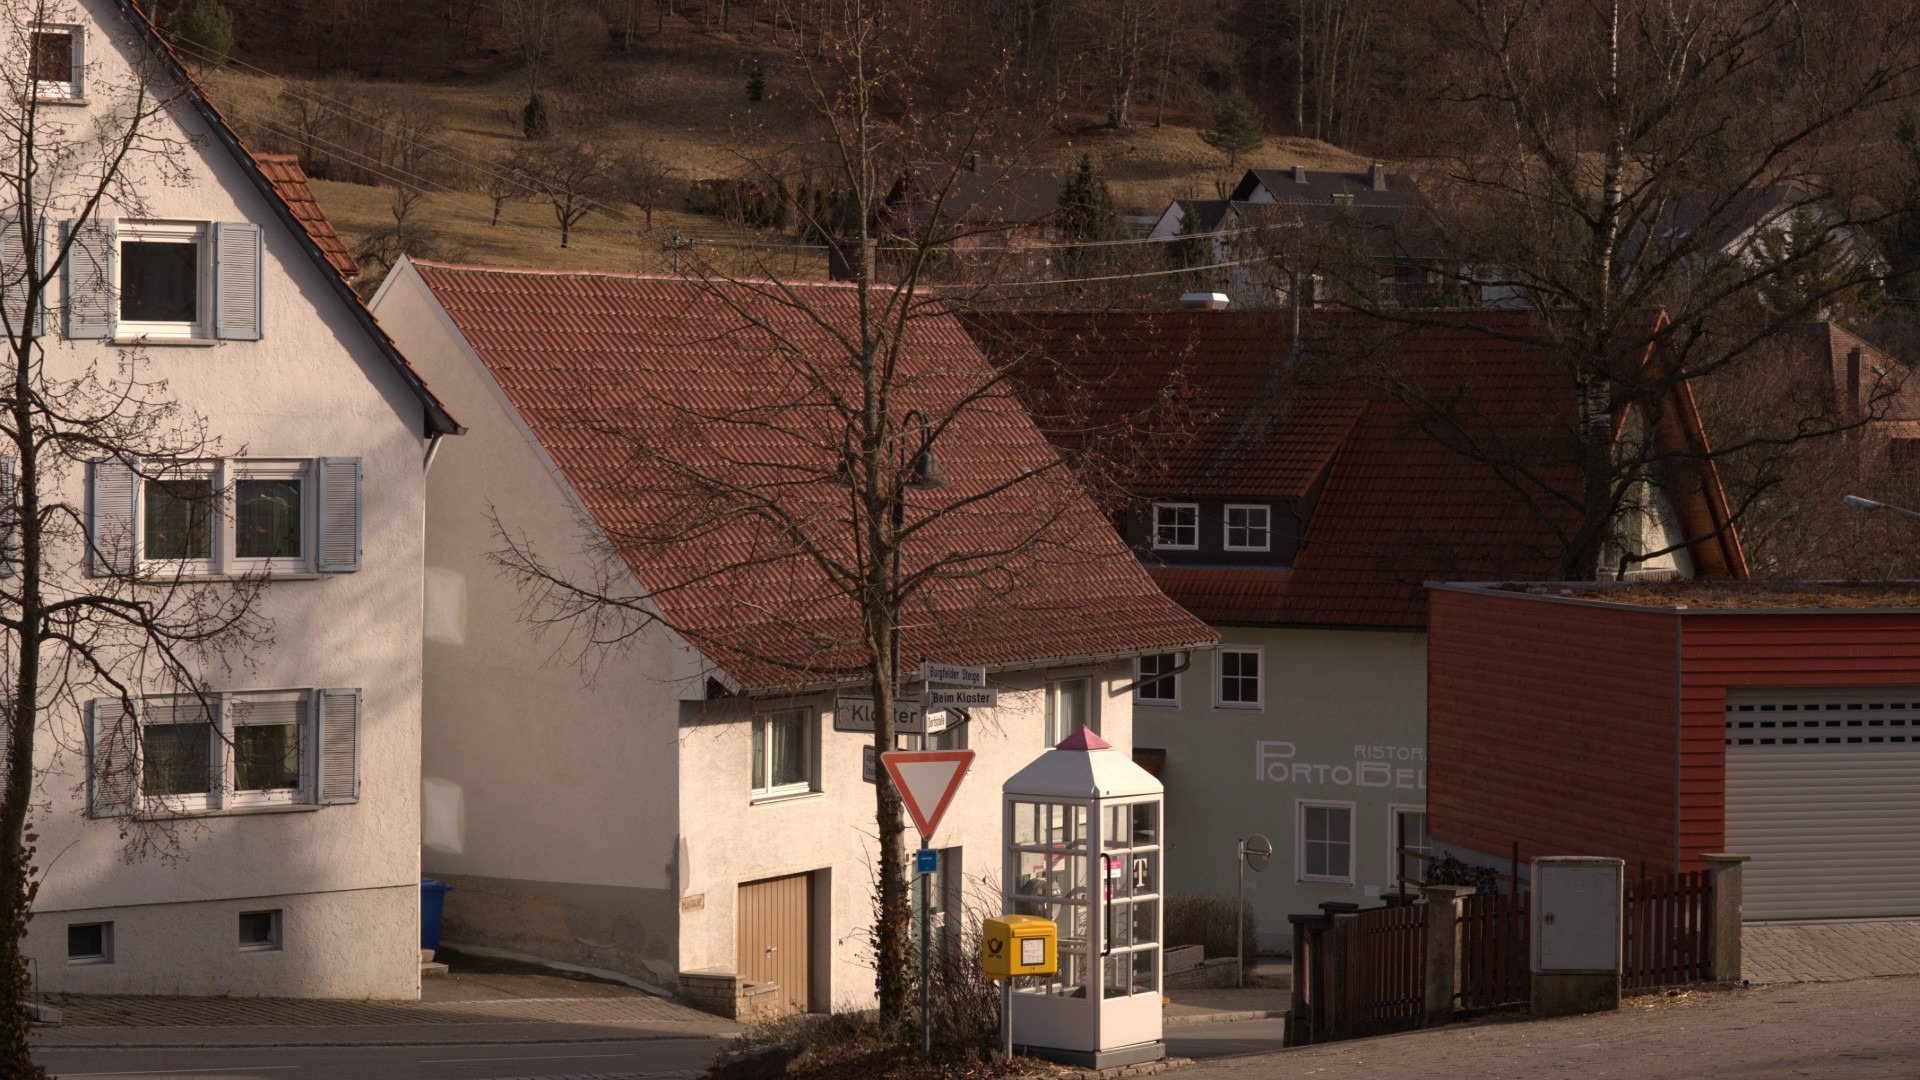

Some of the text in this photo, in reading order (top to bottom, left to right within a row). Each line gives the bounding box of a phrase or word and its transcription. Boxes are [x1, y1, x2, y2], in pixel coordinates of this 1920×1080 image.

[930, 667, 980, 684] Burgfelder Steige
[933, 692, 990, 704] Beim Kloster
[852, 705, 918, 724] Klter
[1354, 744, 1427, 761] RISTOR
[1133, 858, 1148, 887] T
